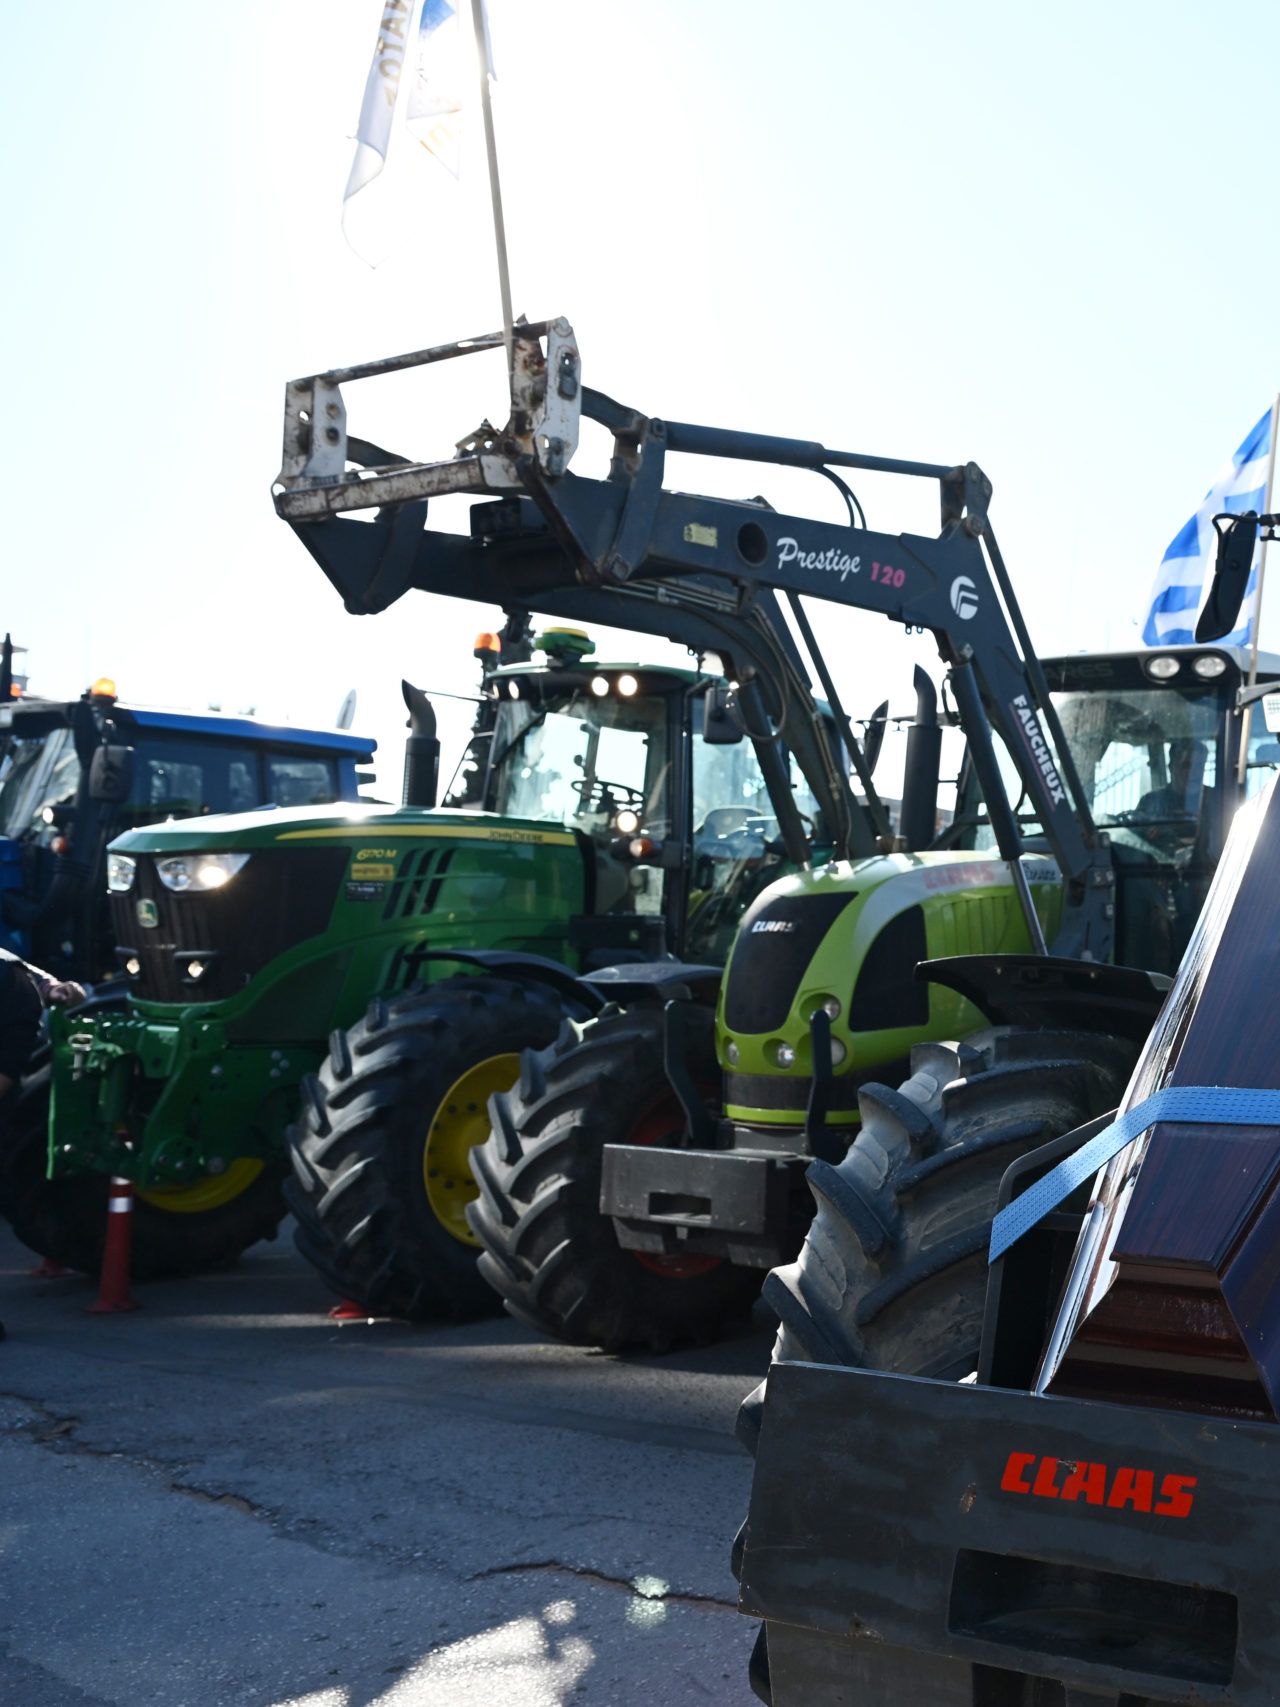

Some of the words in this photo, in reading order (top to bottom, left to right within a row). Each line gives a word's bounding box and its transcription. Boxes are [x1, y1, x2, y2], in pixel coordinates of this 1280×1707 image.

[776, 537, 861, 582] Prestige
[870, 562, 906, 589] 120
[1013, 694, 1066, 806] FAUCHEUX
[922, 863, 996, 890] CLAAS
[751, 920, 797, 933] CLAAS
[1001, 1452, 1198, 1518] CLAAS
